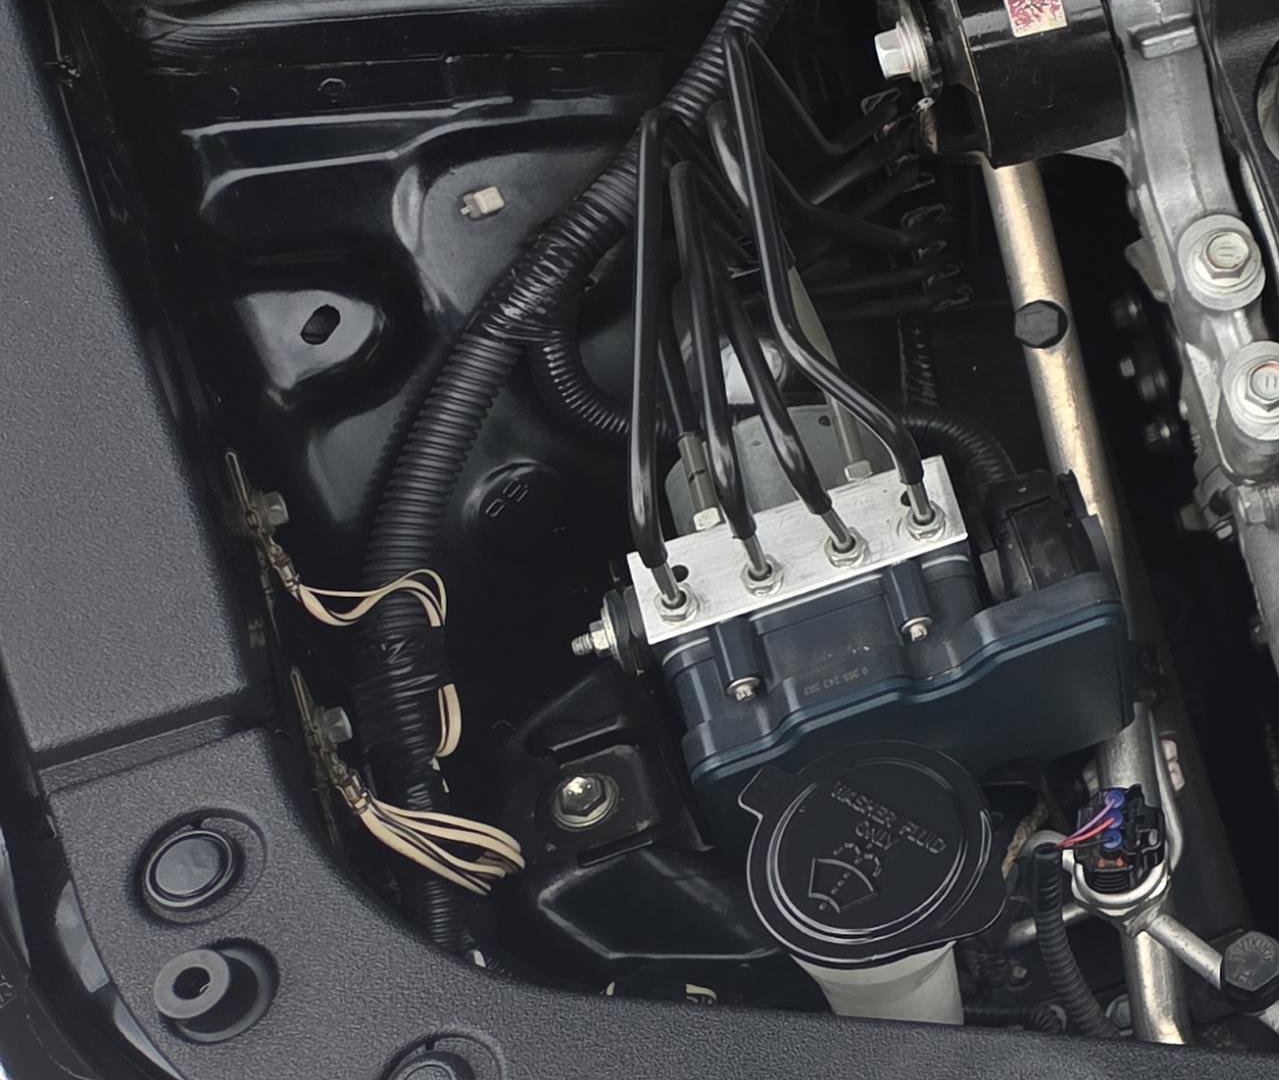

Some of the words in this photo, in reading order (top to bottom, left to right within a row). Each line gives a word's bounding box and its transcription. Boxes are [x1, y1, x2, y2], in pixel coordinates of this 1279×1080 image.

[829, 781, 898, 829] WASHER
[899, 821, 947, 855] FLUID
[855, 821, 900, 851] ONLY
